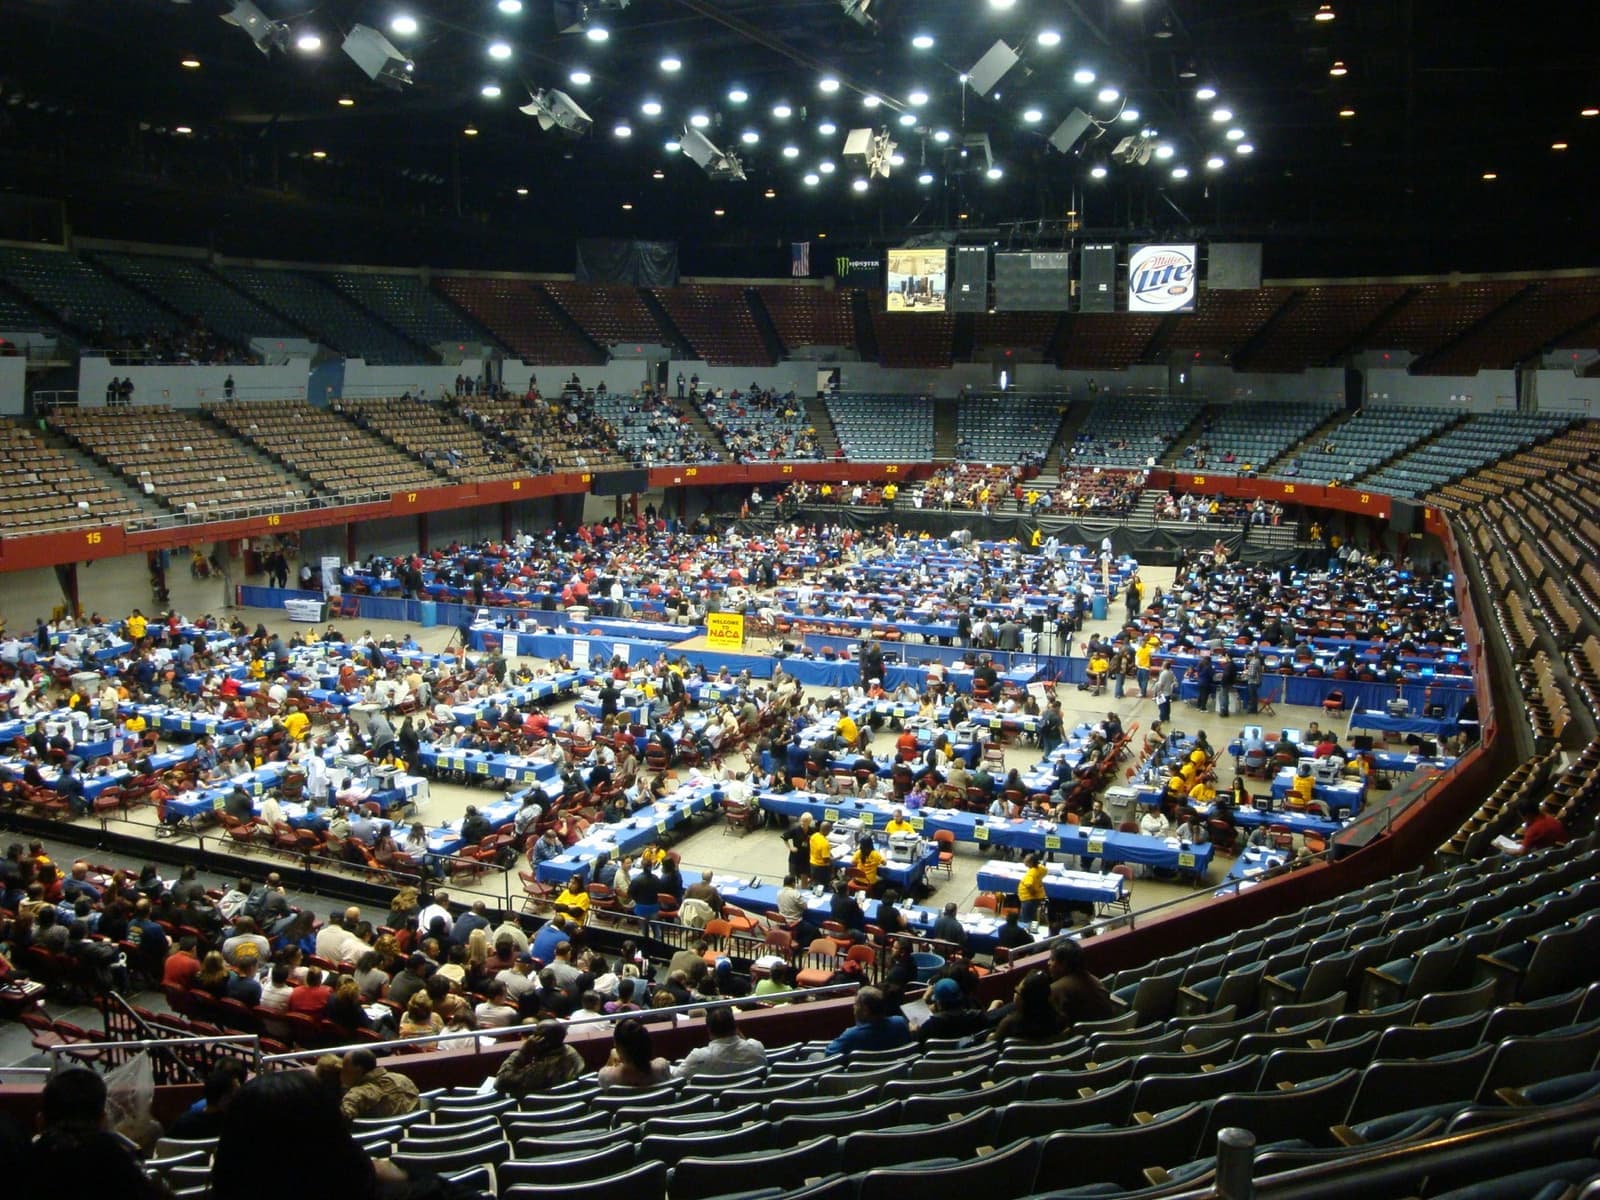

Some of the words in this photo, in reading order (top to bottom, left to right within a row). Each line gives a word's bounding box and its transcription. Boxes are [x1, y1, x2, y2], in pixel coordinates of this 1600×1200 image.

[1150, 255, 1184, 269] Miller
[1135, 264, 1193, 294] Lite
[686, 468, 697, 476] 20
[408, 493, 417, 503] 17
[1361, 494, 1370, 503] 27
[267, 516, 280, 525] 16
[86, 532, 102, 544] 15
[710, 630, 740, 638] NACA
